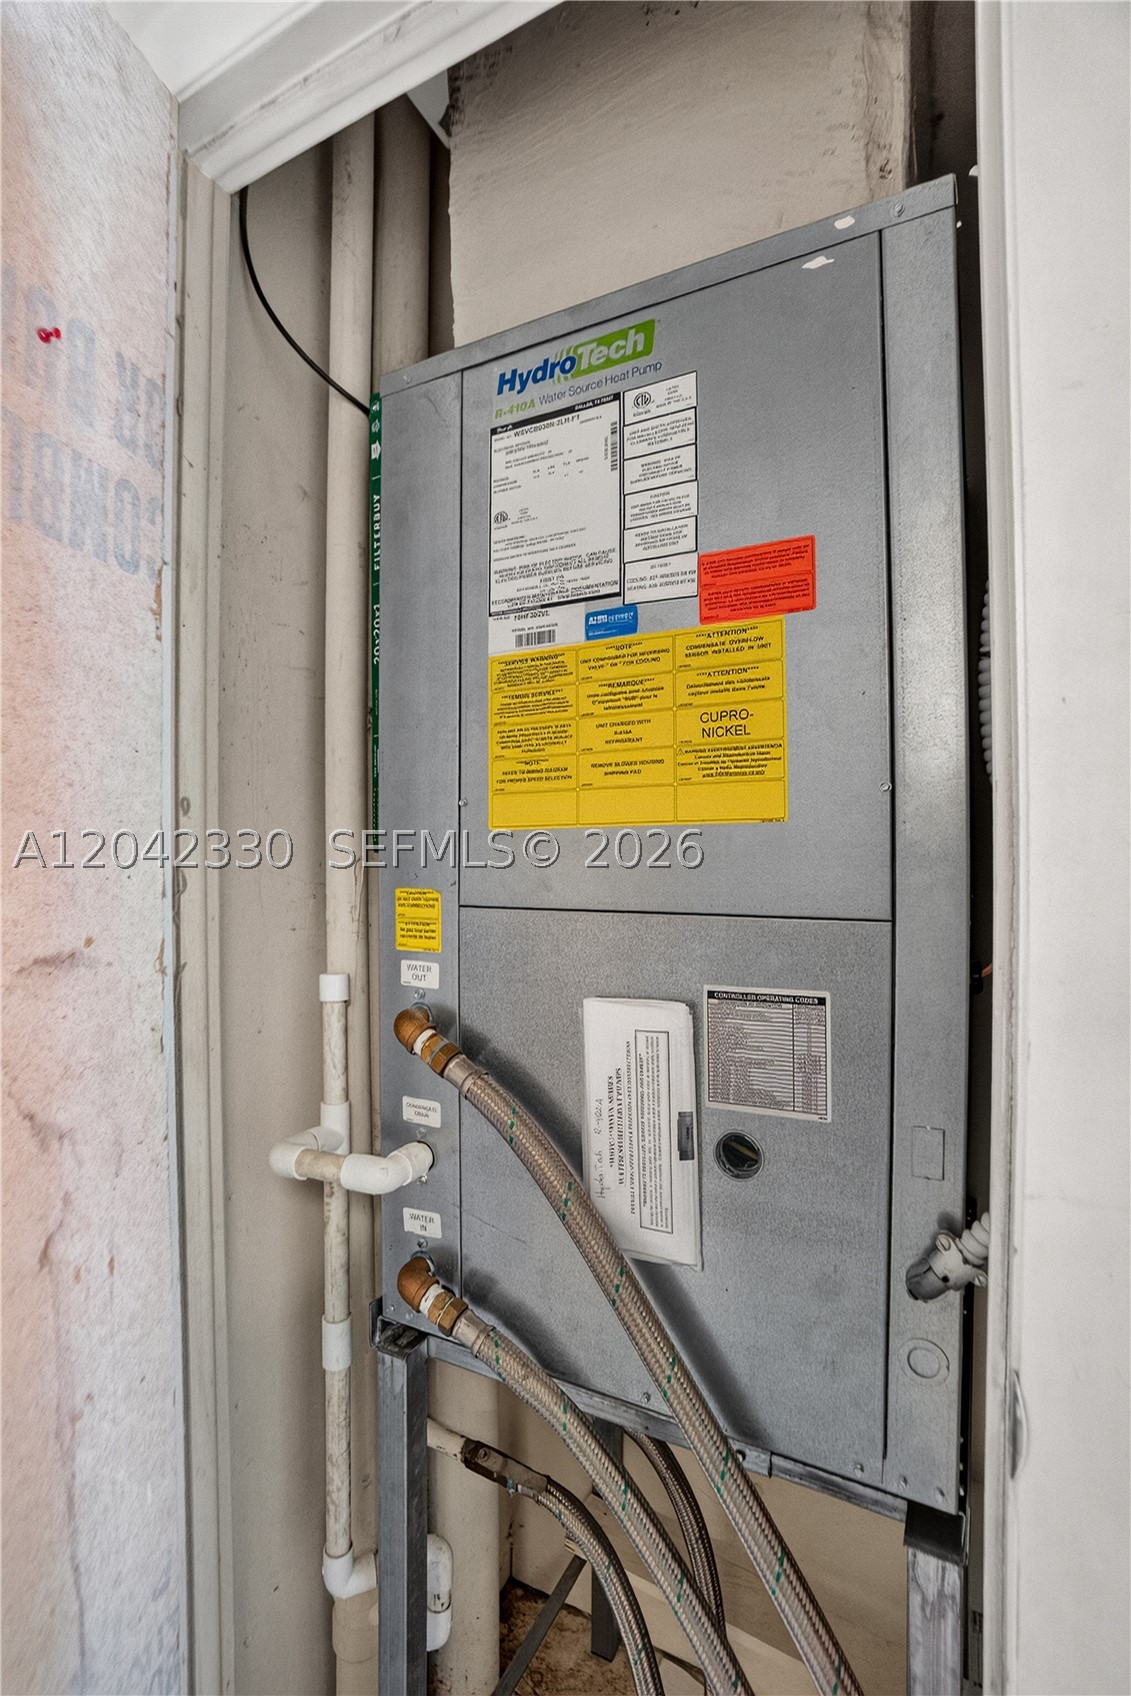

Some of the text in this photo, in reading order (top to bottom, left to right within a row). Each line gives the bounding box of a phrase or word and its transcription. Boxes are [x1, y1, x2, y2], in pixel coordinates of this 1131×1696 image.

[497, 328, 645, 396] HydroTech
[494, 361, 663, 420] R-410A Water Source Heat Pump
[373, 494, 381, 571] FILTERBUY
[699, 708, 754, 724] CUPRO-
[701, 724, 751, 739] NICKEL
[406, 963, 432, 973] WATER
[411, 972, 426, 982] OUT
[713, 991, 819, 1004] CONTROLLER OPERATING CODES
[414, 1110, 430, 1119] DRAIN
[409, 1212, 436, 1225] WATER
[419, 1224, 428, 1232] IN
